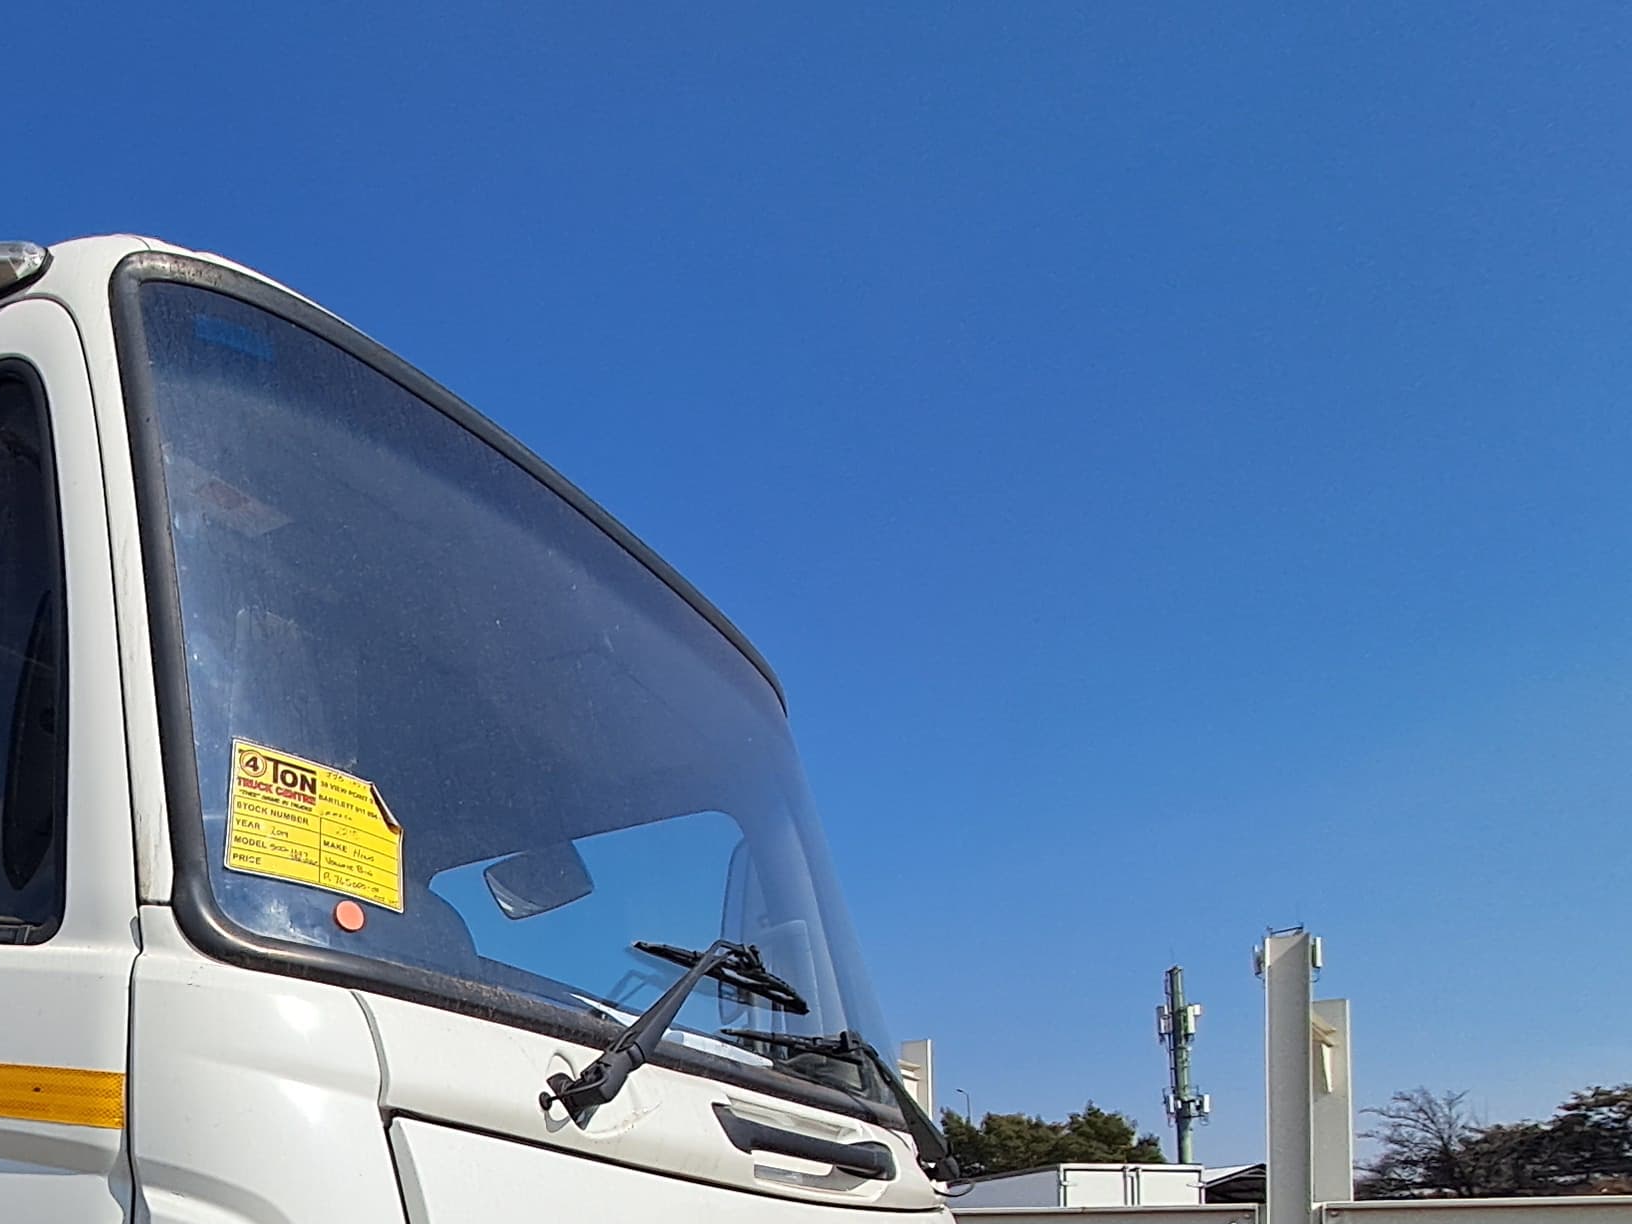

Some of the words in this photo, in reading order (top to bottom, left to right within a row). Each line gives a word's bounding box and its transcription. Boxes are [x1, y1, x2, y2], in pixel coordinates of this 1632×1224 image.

[237, 776, 273, 794] TRUCK
[275, 786, 317, 806] CENTRE
[236, 801, 268, 815] STOCK
[270, 809, 310, 825] NUMBER
[235, 818, 261, 830] YEAR
[233, 835, 267, 849] MODEL
[323, 839, 348, 854] MAKE
[232, 852, 263, 865] PRICE
